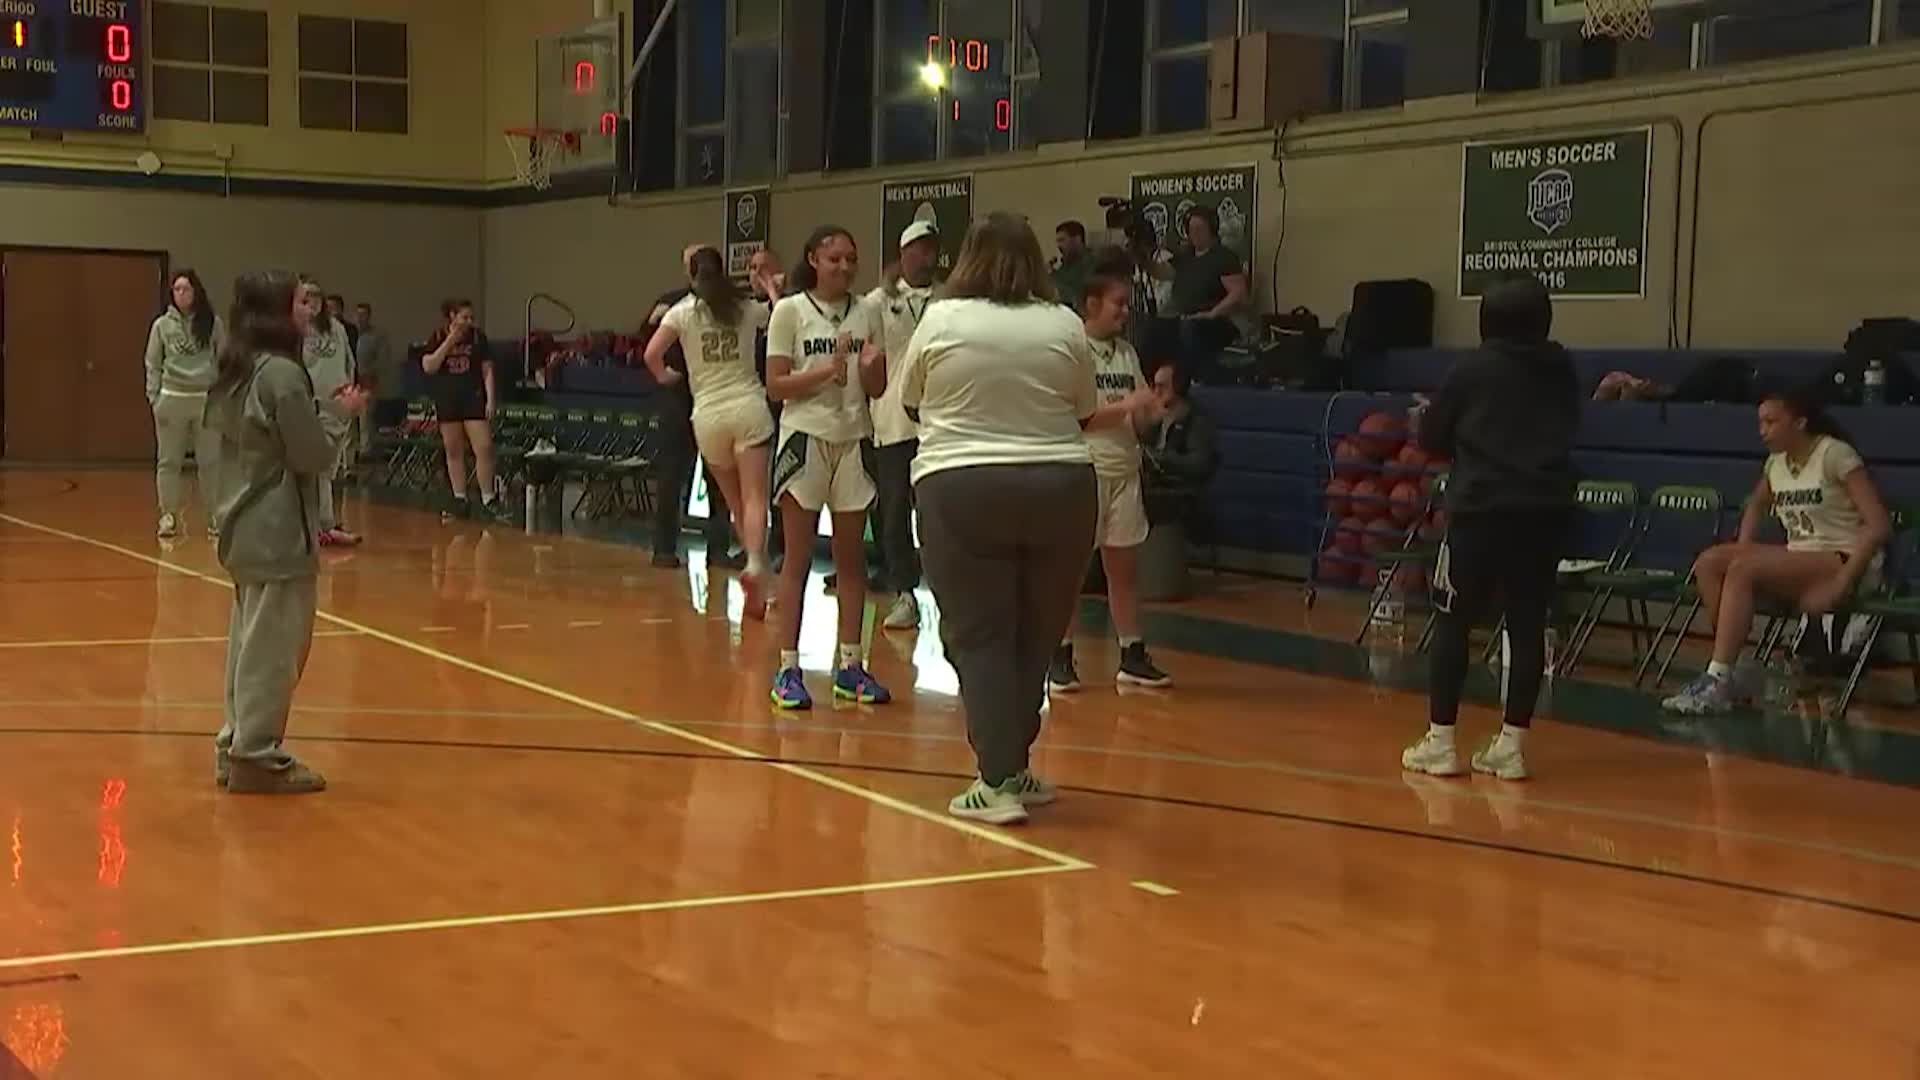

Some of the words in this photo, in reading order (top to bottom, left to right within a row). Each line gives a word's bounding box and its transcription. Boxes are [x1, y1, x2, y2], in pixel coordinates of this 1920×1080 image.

[69, 0, 128, 18] GUEST
[107, 24, 131, 61] 0
[26, 57, 58, 73] FOUL
[97, 63, 137, 79] FOULS
[111, 80, 131, 109] 0
[98, 113, 137, 128] SCORE
[1490, 148, 1542, 169] MEN'S
[1546, 141, 1617, 166] SOCCER
[912, 180, 968, 200] BASKETBALL
[1140, 178, 1194, 196] WOMEN'S
[1196, 173, 1245, 192] SOCCER
[1484, 240, 1519, 251] BRISTOL
[1521, 238, 1573, 250] COMMUNITY
[1575, 235, 1617, 249] COLLEGE
[1464, 251, 1539, 271] REGIONAL
[1543, 247, 1638, 268] CHAMPIONS
[1535, 271, 1566, 289] 016
[701, 331, 740, 363] 22
[1577, 489, 1624, 505] BRISTOL
[1660, 494, 1708, 511] BRISTOL
